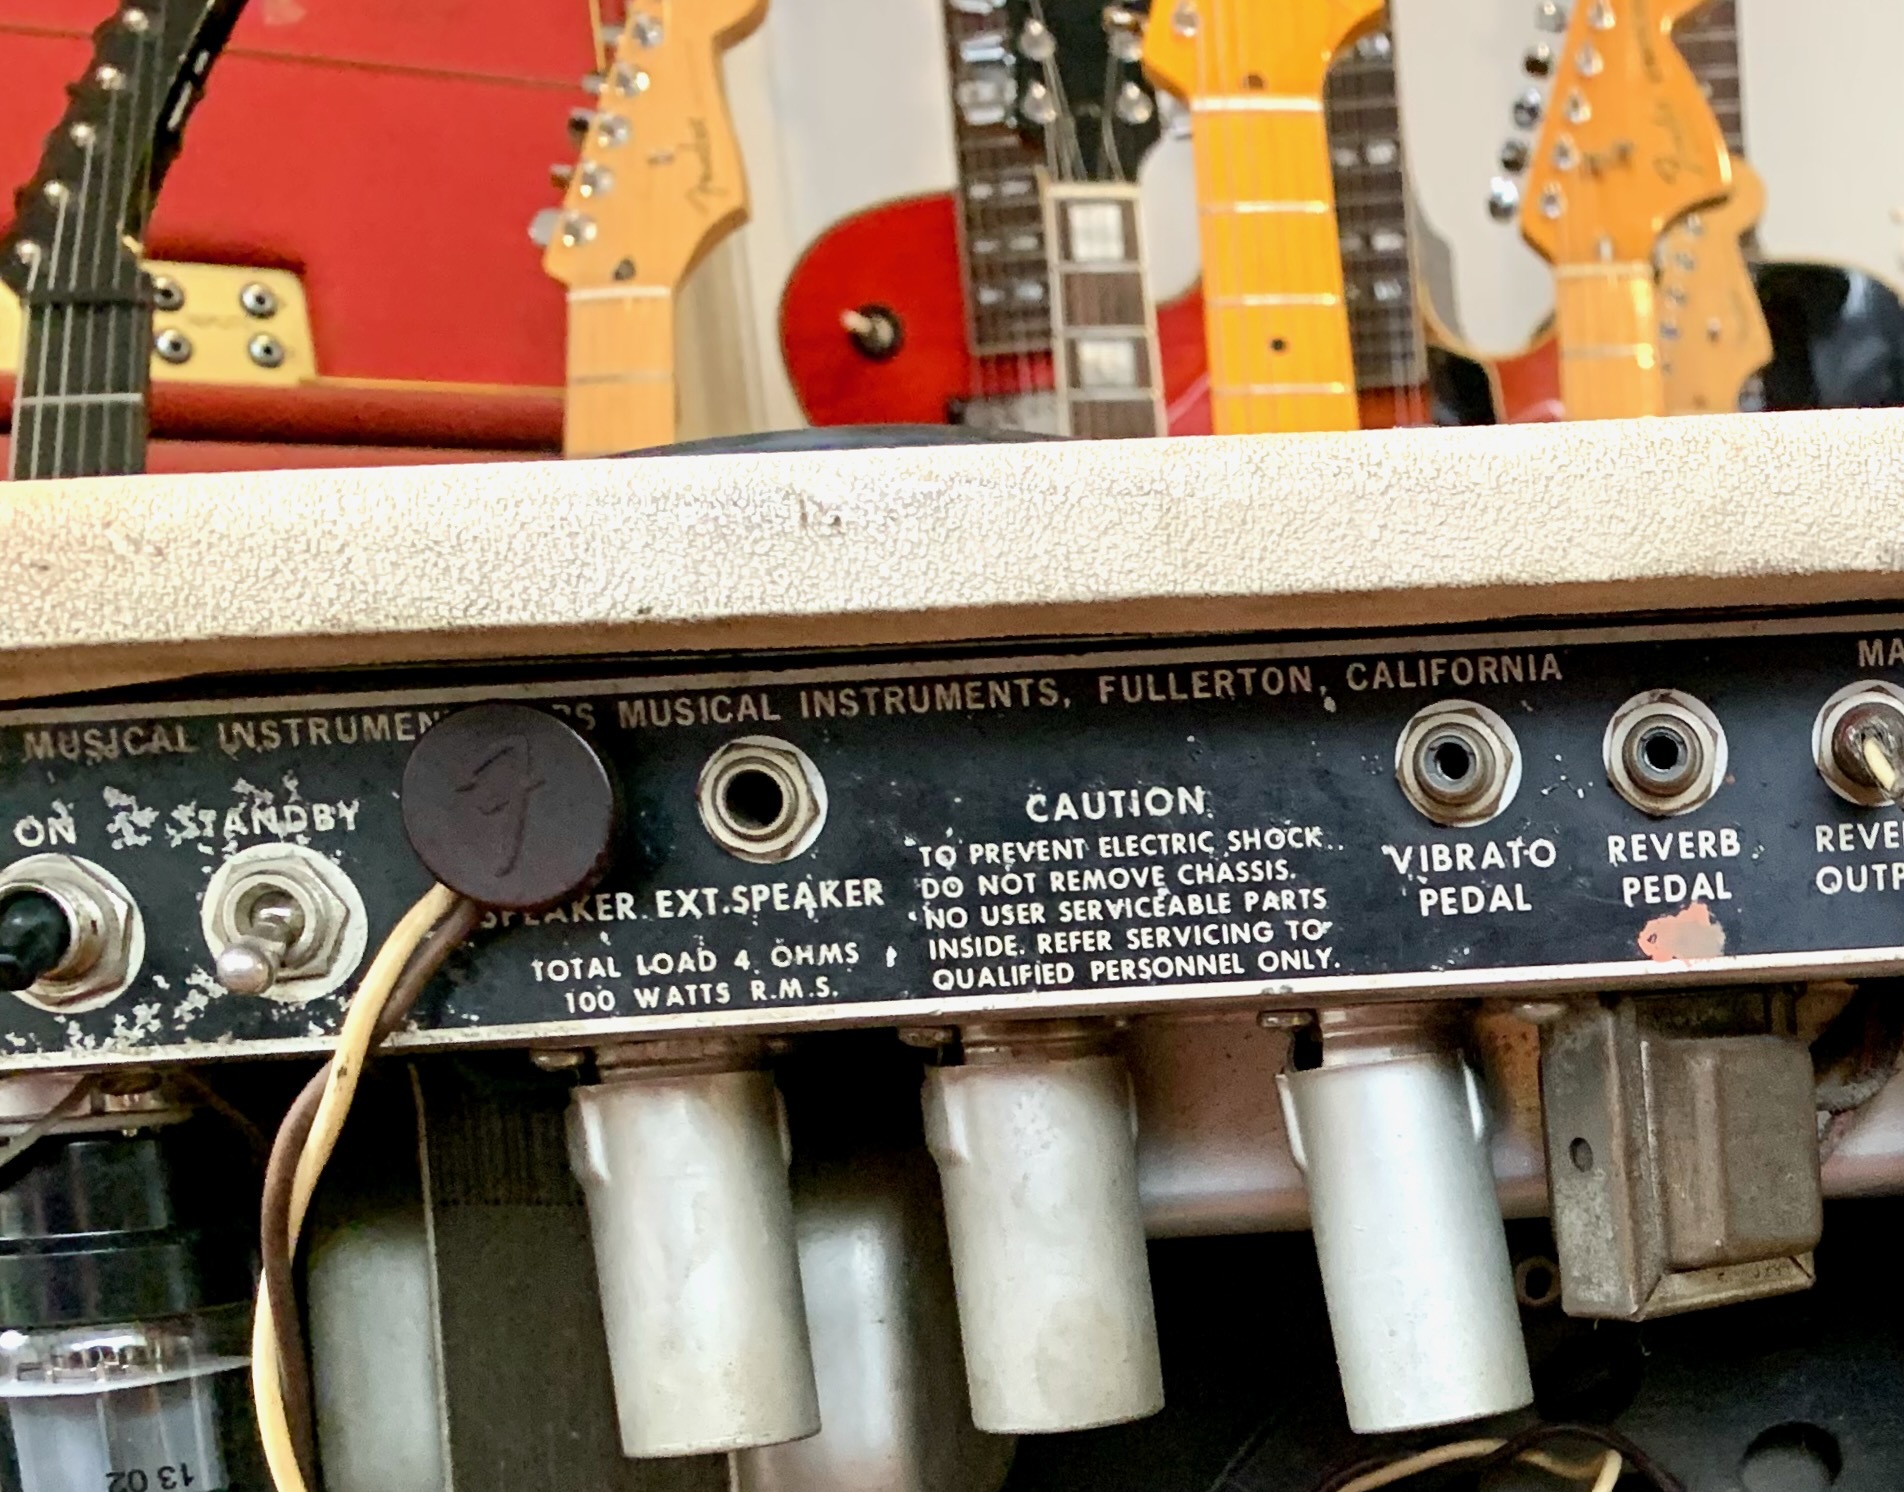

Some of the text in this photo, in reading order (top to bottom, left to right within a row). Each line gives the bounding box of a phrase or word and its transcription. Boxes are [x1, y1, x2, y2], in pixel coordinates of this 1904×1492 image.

[618, 692, 781, 730] MUSICAL
[801, 677, 1071, 718] INSTRUMENTS,
[1098, 664, 1327, 705] FULLERTON,
[1345, 652, 1563, 692] CALIFORNIA
[22, 708, 450, 760] MUSICAL INSTRUMEN
[167, 799, 361, 842] STANDBY
[1024, 785, 1208, 824] CAUTION
[13, 810, 77, 847] ON
[1606, 826, 1743, 864] REVERB
[919, 845, 957, 868] TO
[969, 837, 1088, 866] PREVENT
[1098, 830, 1215, 860] ELECTRIC
[1382, 838, 1557, 876] VIBRATO
[921, 859, 1297, 901] DO NOT REMOVE CHASSIS.
[1418, 882, 1532, 917] PEDAL
[1621, 870, 1733, 908] PEDAL
[924, 887, 1328, 931] NO USER SERVICEABLE PARTS
[929, 917, 1325, 961] INSIDE. REFER SERVICING TO
[531, 942, 860, 985] TOTAL LOAD 4 OHMS
[932, 946, 1341, 992] QUALIFIED PERSONNEL ONLY.
[564, 975, 839, 1015] 100 WATTS R.M.S.
[156, 1462, 196, 1491] 13
